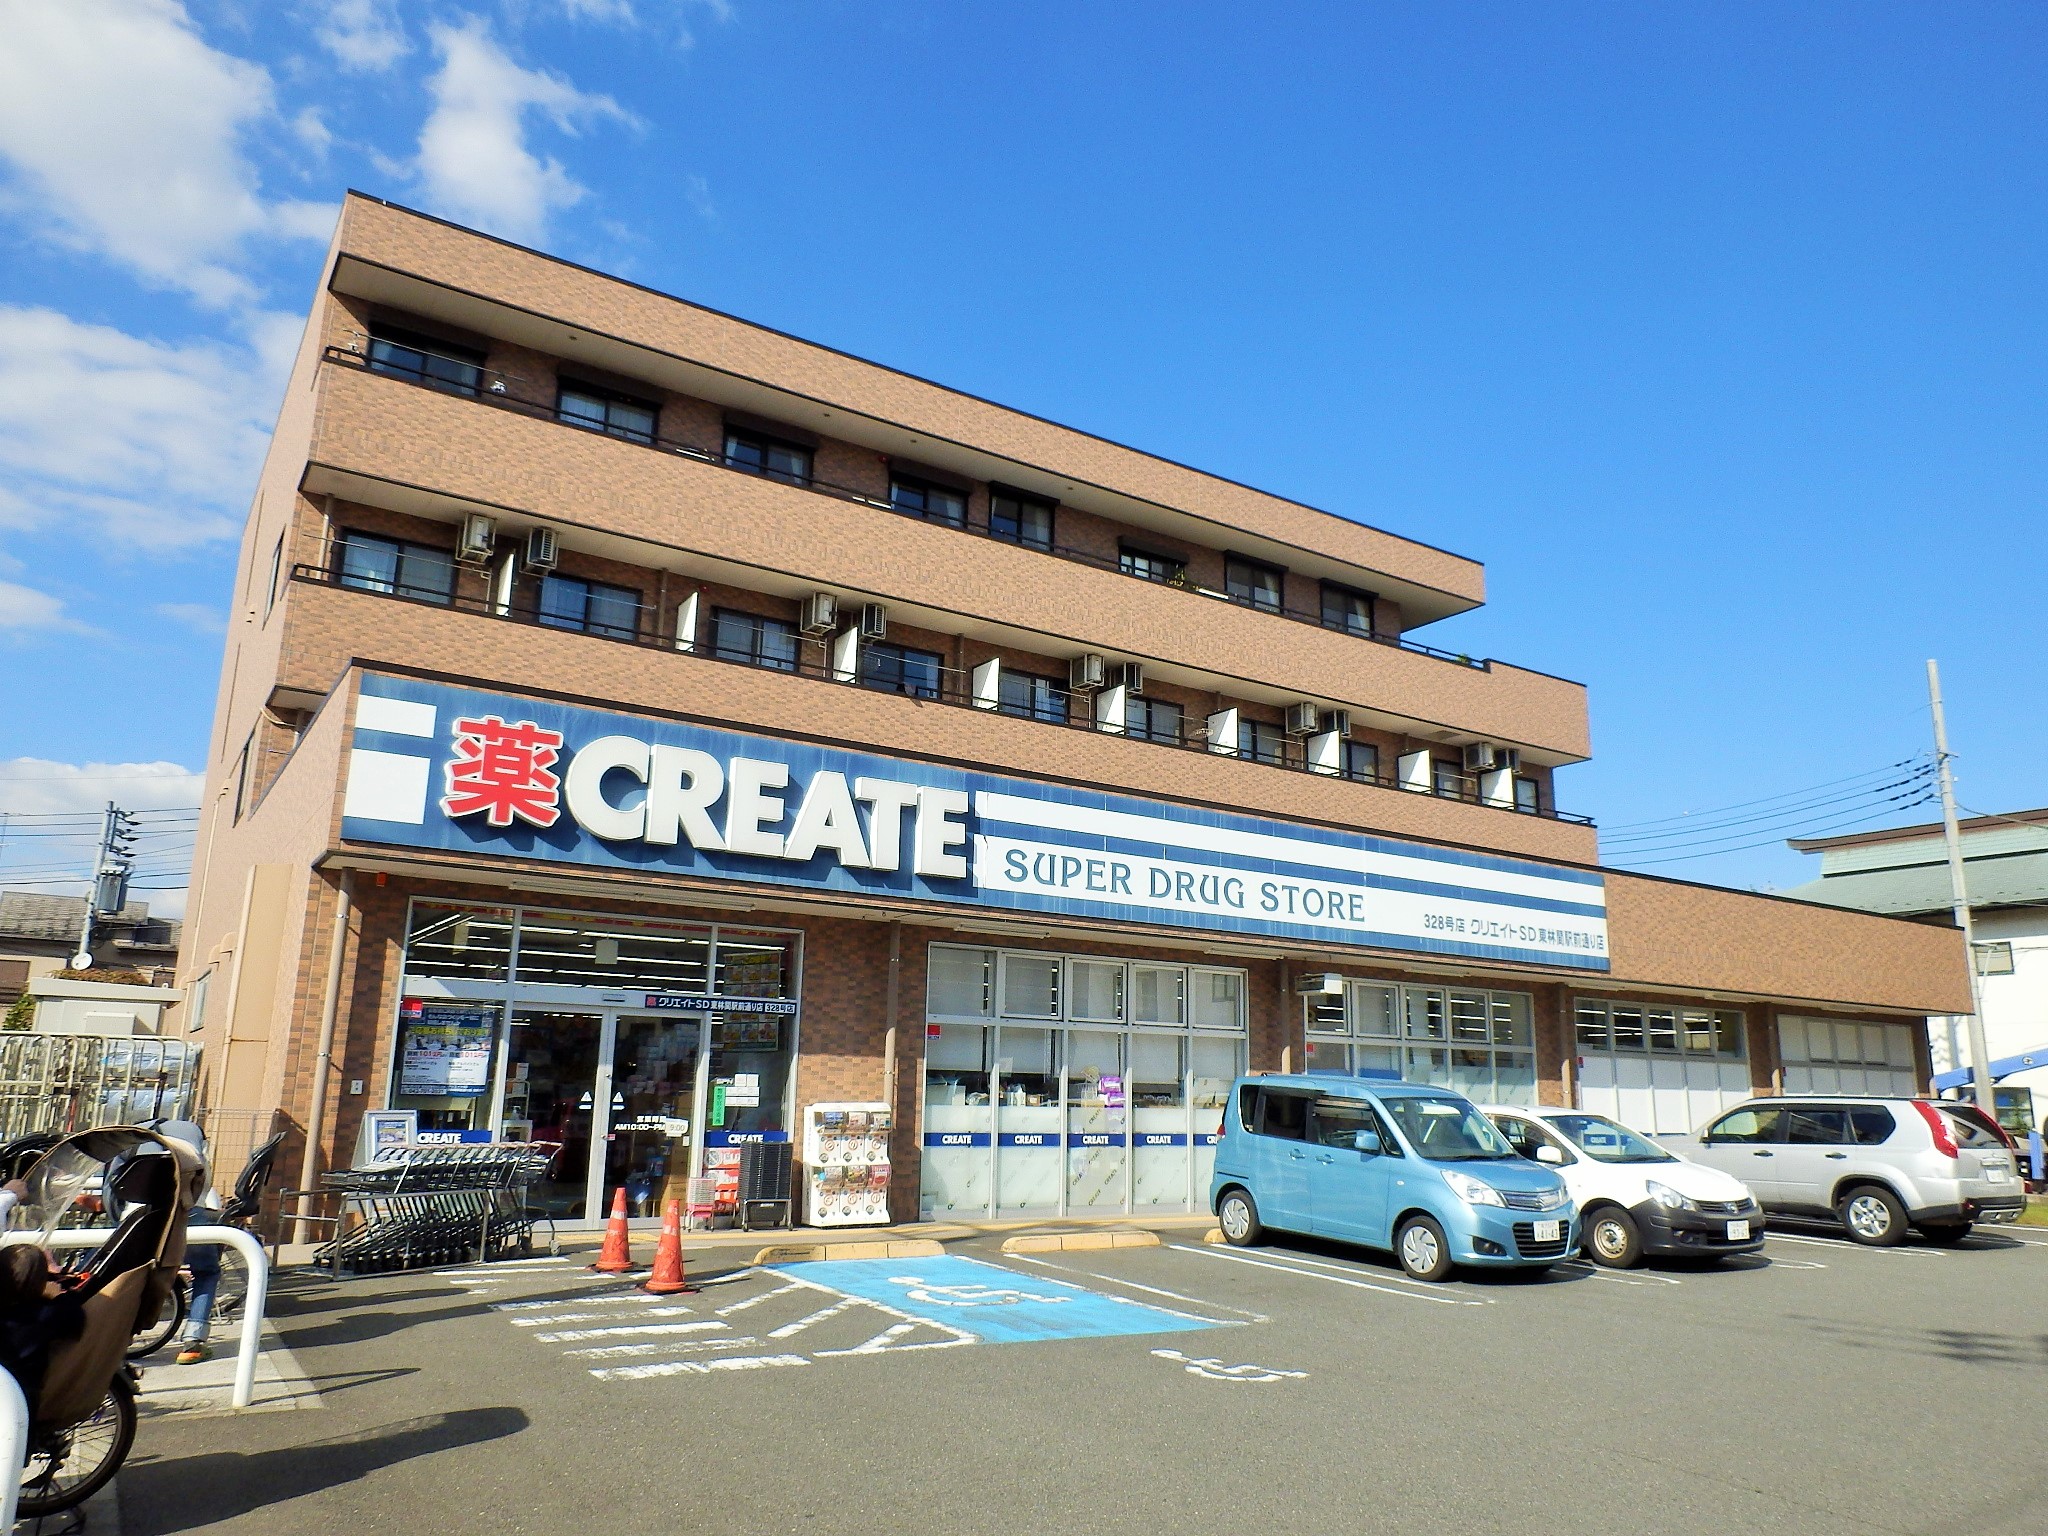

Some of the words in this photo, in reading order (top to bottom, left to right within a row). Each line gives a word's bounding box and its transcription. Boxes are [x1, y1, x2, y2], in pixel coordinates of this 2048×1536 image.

[442, 714, 564, 829] 薬
[564, 736, 968, 878] CREATE
[1004, 848, 1132, 895] SUPER
[1149, 866, 1244, 908] DRUG
[1260, 881, 1365, 923] STORE
[1424, 913, 1465, 933] 328号店
[766, 1003, 794, 1013] 328号店
[417, 1132, 462, 1144] CREATE
[728, 1134, 764, 1144] CREATE
[942, 1135, 972, 1144] CREATE
[1014, 1135, 1042, 1144] CREATE
[1082, 1136, 1109, 1145] CREATE
[1146, 1135, 1171, 1144] CREATE
